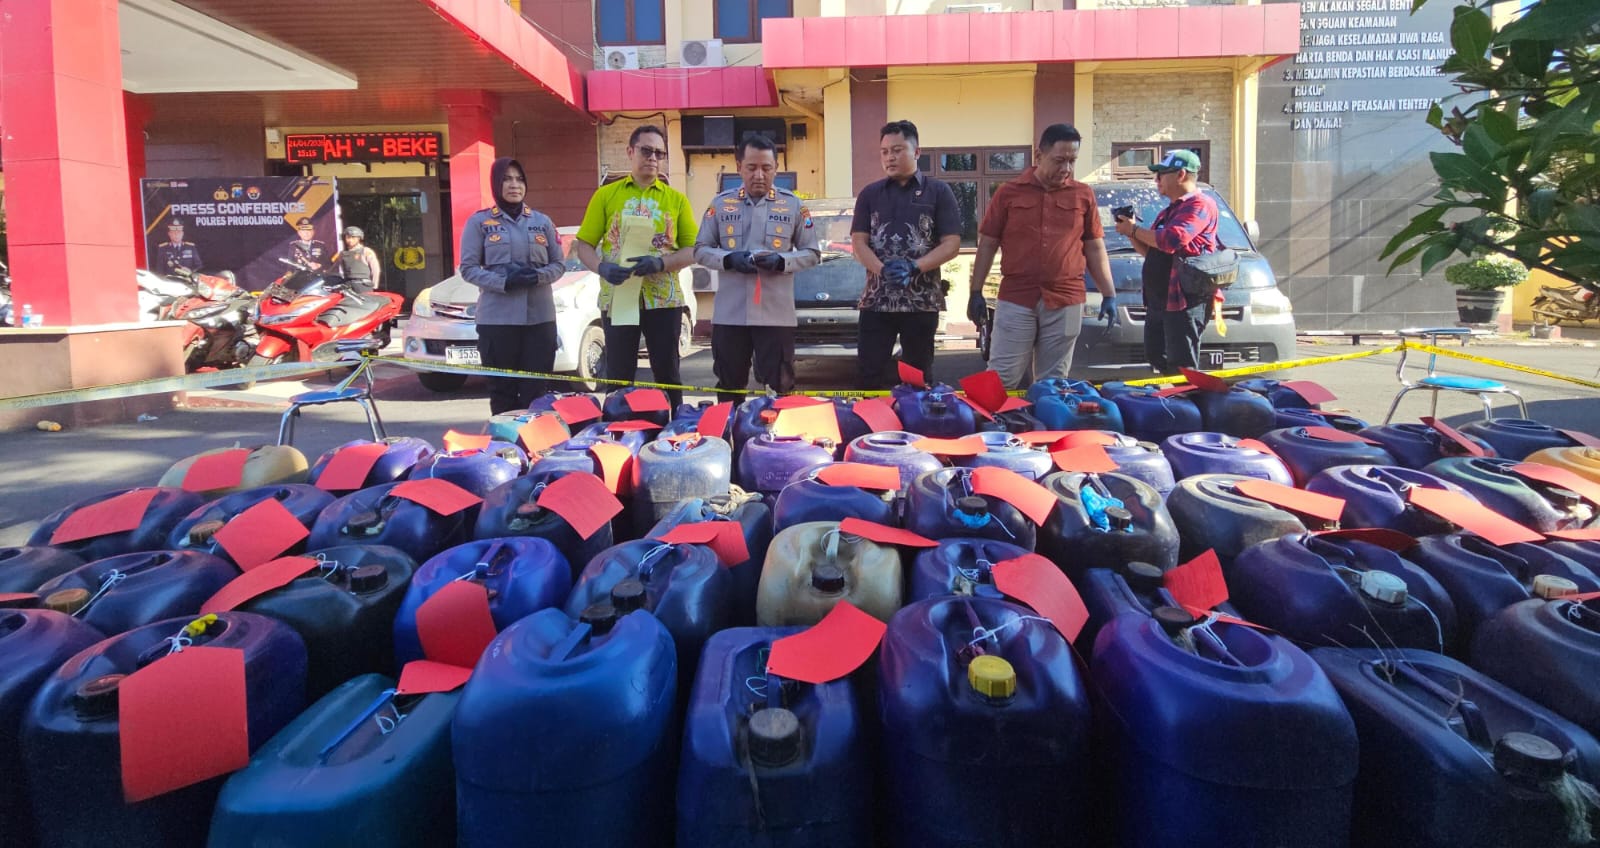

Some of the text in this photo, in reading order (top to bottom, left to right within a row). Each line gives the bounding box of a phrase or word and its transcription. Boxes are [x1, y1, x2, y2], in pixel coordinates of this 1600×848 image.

[1356, 0, 1388, 12] SEGALA
[1389, 0, 1423, 11] BENT
[1348, 15, 1397, 28] KEAMANAN
[1337, 32, 1397, 46] KESELAMATAN
[1398, 31, 1420, 44] JIWA
[1421, 31, 1445, 43] RAGA
[1295, 51, 1324, 64] HARTA
[1326, 50, 1353, 63] BENDA
[1355, 50, 1374, 62] DAN
[1375, 49, 1394, 61] HAK
[1395, 49, 1421, 61] ASASI
[1284, 65, 1446, 81] 3. MENJAMIN KEPASTIAN BERDASARK
[1294, 100, 1349, 113] MEMELIHARA
[1351, 99, 1395, 111] PERASAAN
[1294, 117, 1311, 130] DAN
[324, 138, 353, 158] AH
[383, 137, 438, 157] BEKE
[170, 201, 307, 216] PRESS CONFERENCE
[195, 215, 284, 227] POLRES PROBOLINGGO
[720, 214, 742, 222] LATIF
[768, 215, 791, 223] POLRI
[447, 349, 453, 359] N
[1209, 352, 1222, 365] TD
